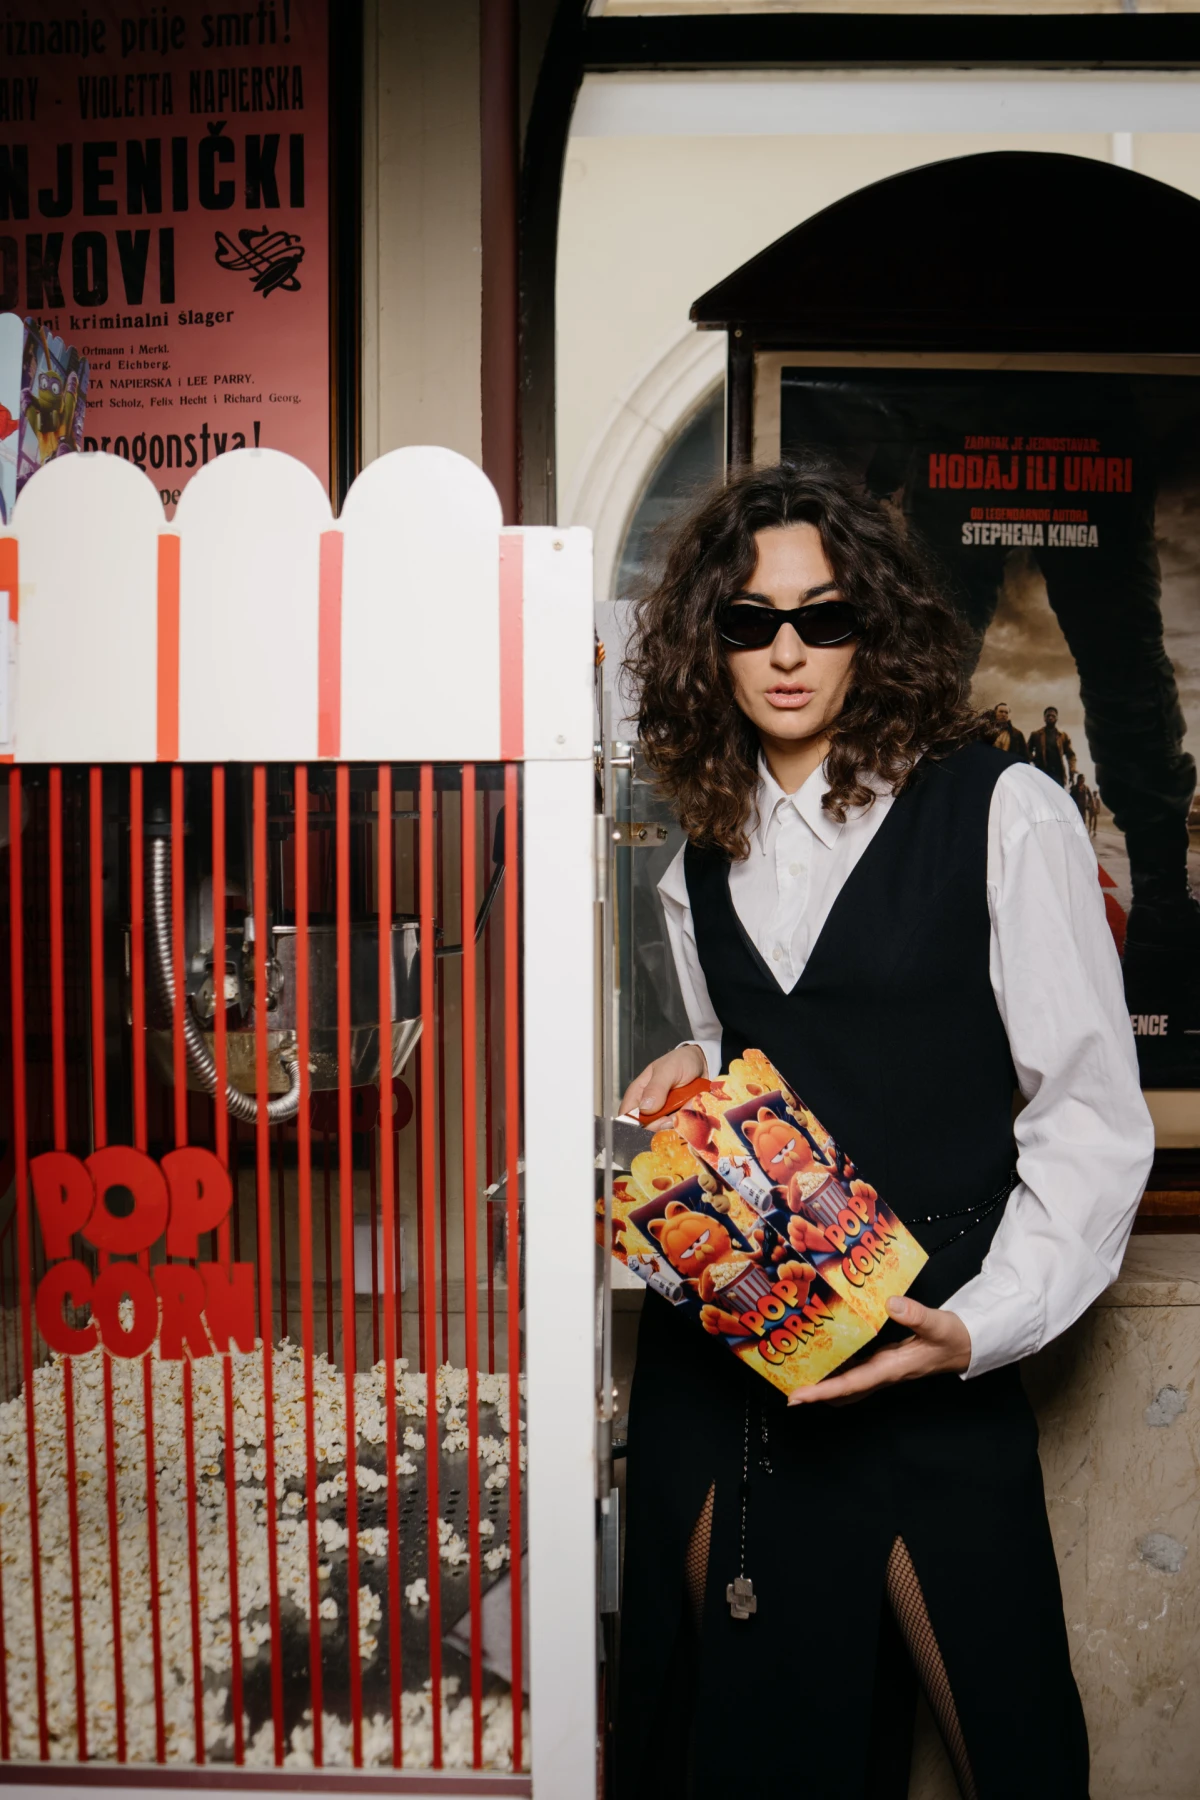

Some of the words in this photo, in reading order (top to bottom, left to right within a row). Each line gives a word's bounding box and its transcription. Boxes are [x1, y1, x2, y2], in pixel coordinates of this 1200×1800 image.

[0, 9, 106, 58] iznanje
[121, 6, 186, 58] prije
[78, 72, 173, 120] VIOLETTA
[189, 65, 304, 114] NAPIERSKA
[0, 121, 304, 220] NJENIČKI
[70, 311, 169, 331] kriminalni
[178, 309, 235, 327] šlager
[82, 345, 125, 357] Ortmann
[130, 345, 135, 355] i
[138, 344, 170, 355] Merkl.
[89, 360, 110, 370] ard
[118, 360, 171, 372] Eichberg.
[110, 378, 172, 389] NAPIERSKA
[187, 376, 208, 387] LEE
[213, 374, 255, 385] PARRY.
[110, 398, 144, 409] Scholz,
[150, 396, 173, 407] Felix
[180, 396, 207, 406] Hecht
[224, 393, 262, 404] Richard
[269, 392, 302, 405] Georg.
[964, 435, 1009, 451] ZADATAK
[1011, 436, 1024, 451] JE
[928, 453, 1019, 490] HODAJ
[1026, 455, 1057, 491] ILI
[1063, 456, 1133, 492] UMRI
[961, 522, 1045, 546] STEPHENA
[1048, 524, 1099, 547] KINGA
[970, 507, 983, 520] OD
[985, 507, 1051, 522] LEGENDARNOG
[1053, 509, 1089, 523] AUTORA
[30, 1144, 233, 1260] POP
[824, 1195, 870, 1255] POP
[841, 1212, 898, 1288] CORN
[36, 1259, 256, 1361] CORN
[738, 1279, 799, 1338] POP
[757, 1293, 835, 1366] CORN
